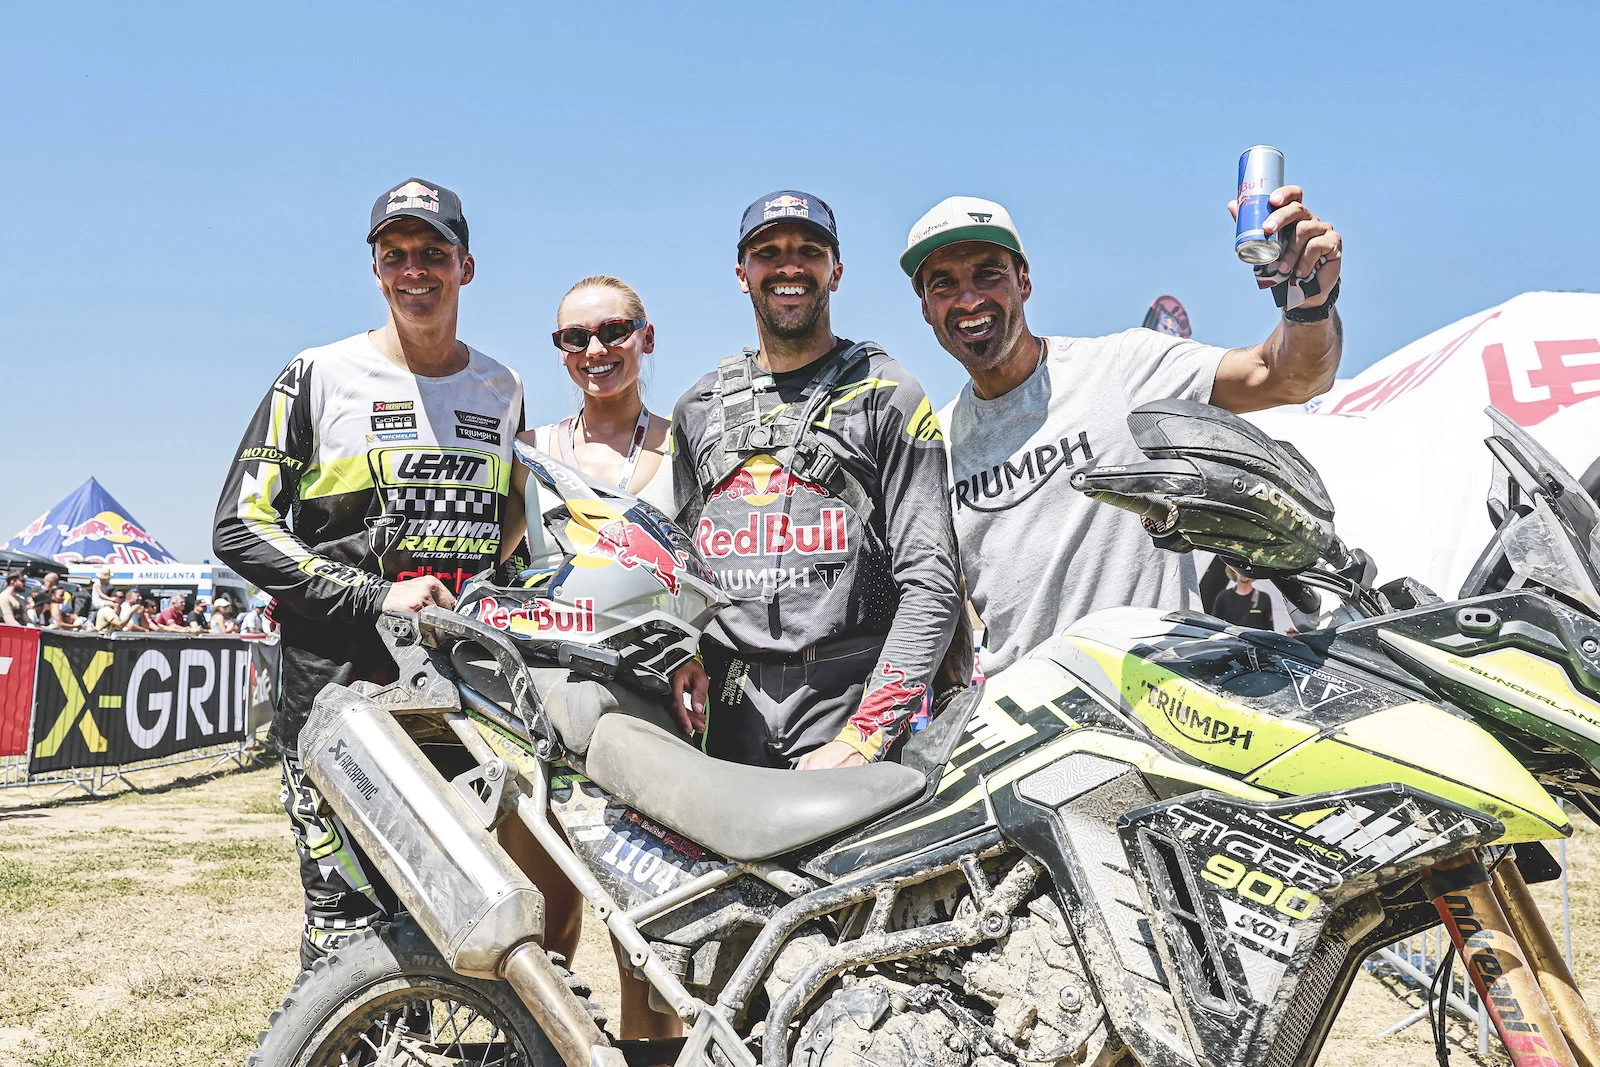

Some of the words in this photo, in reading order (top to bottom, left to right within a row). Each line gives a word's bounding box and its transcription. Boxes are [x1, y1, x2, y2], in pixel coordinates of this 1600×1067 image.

[386, 197, 412, 214] Red
[412, 197, 439, 213] Bull
[763, 208, 786, 220] Red
[787, 207, 809, 219] Bull
[375, 416, 412, 424] GoPro
[381, 433, 417, 441] MICHELIN
[459, 428, 492, 441] TRIUMPH
[397, 453, 487, 481] LEATT
[396, 536, 500, 555] RACING
[694, 511, 760, 558] Red
[763, 508, 849, 556] Bull
[412, 551, 457, 560] FACTORY
[456, 552, 483, 561] TEAM
[138, 572, 196, 580] AMBULANTA
[532, 597, 596, 633] Bull
[1296, 664, 1347, 688] TRIUMPH
[1146, 682, 1253, 750] TRIUMPH
[1234, 812, 1294, 841] RALLY
[1294, 838, 1343, 861] PRO
[601, 830, 683, 895] 1104
[1200, 855, 1321, 921] 900
[1234, 914, 1290, 948] SKDA
[1443, 894, 1541, 1034] ndreani
